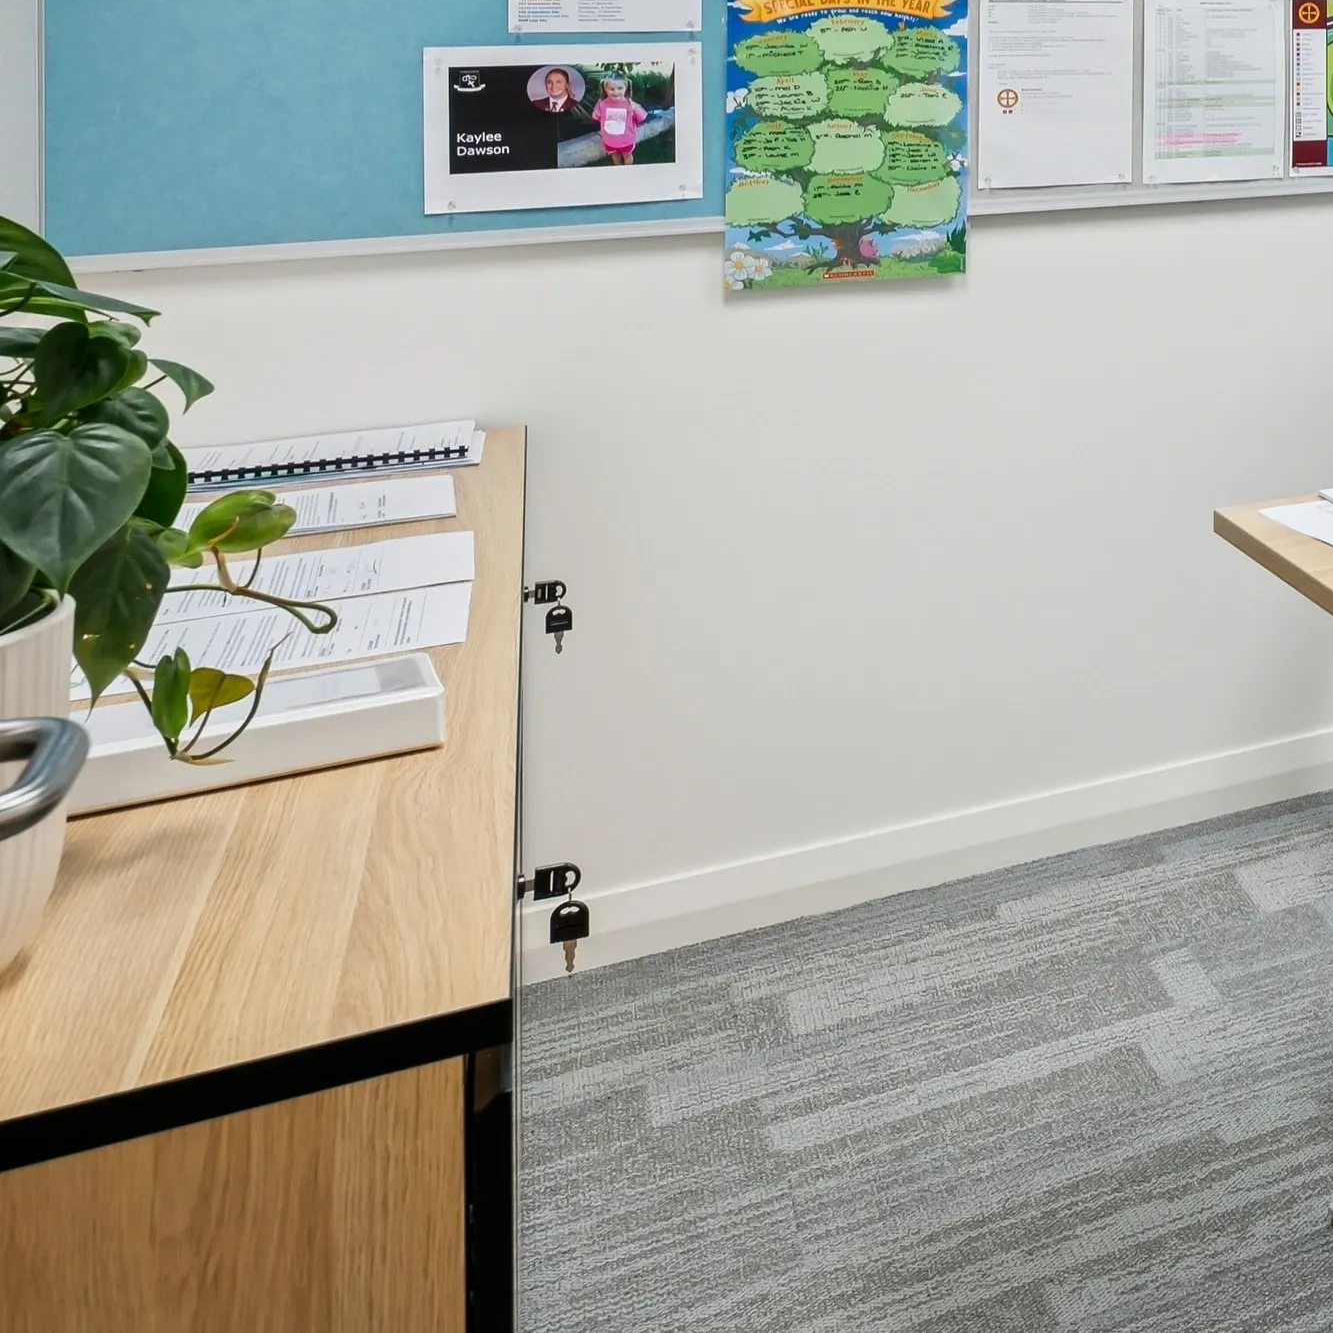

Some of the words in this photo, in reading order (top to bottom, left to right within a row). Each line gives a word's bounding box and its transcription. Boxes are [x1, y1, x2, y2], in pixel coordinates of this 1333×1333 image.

[830, 8, 847, 16] grow
[776, 77, 795, 86] April
[456, 132, 502, 146] Kaylee
[456, 145, 510, 157] Dawson
